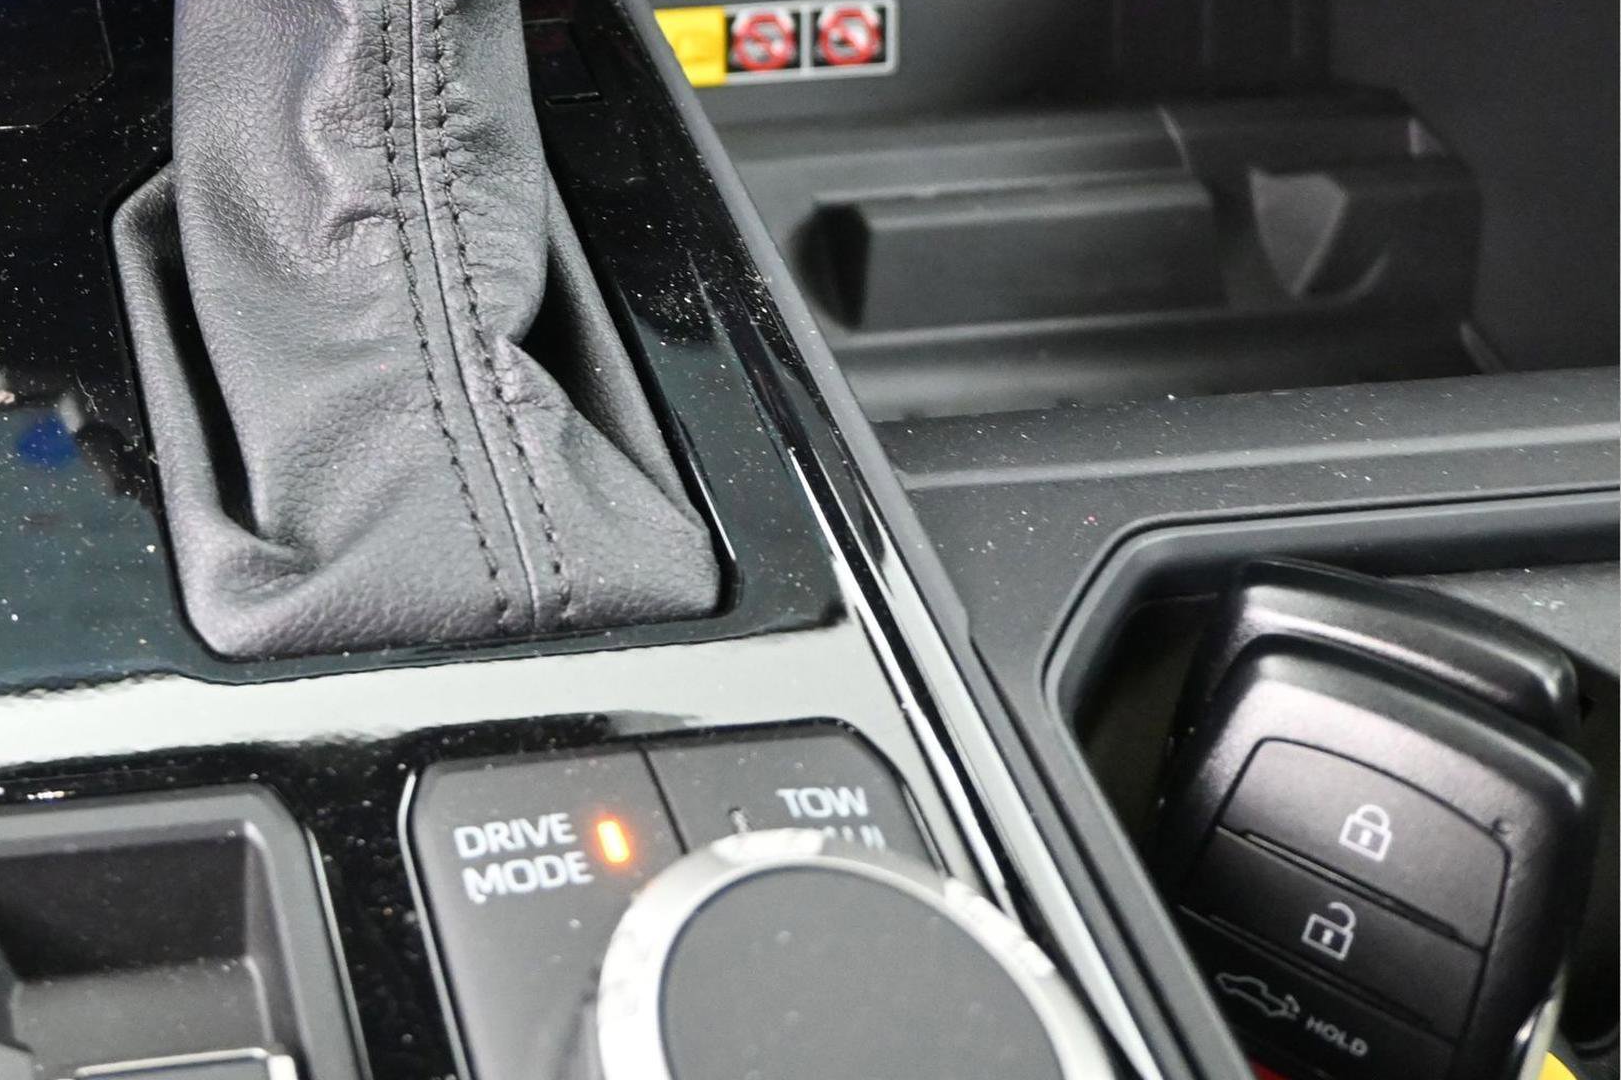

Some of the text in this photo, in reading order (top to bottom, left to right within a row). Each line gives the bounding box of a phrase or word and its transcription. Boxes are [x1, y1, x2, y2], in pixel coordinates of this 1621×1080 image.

[775, 786, 869, 819] TOW
[453, 812, 576, 860] DRIVE
[462, 851, 594, 904] MODE
[1304, 1012, 1369, 1059] HOLD
